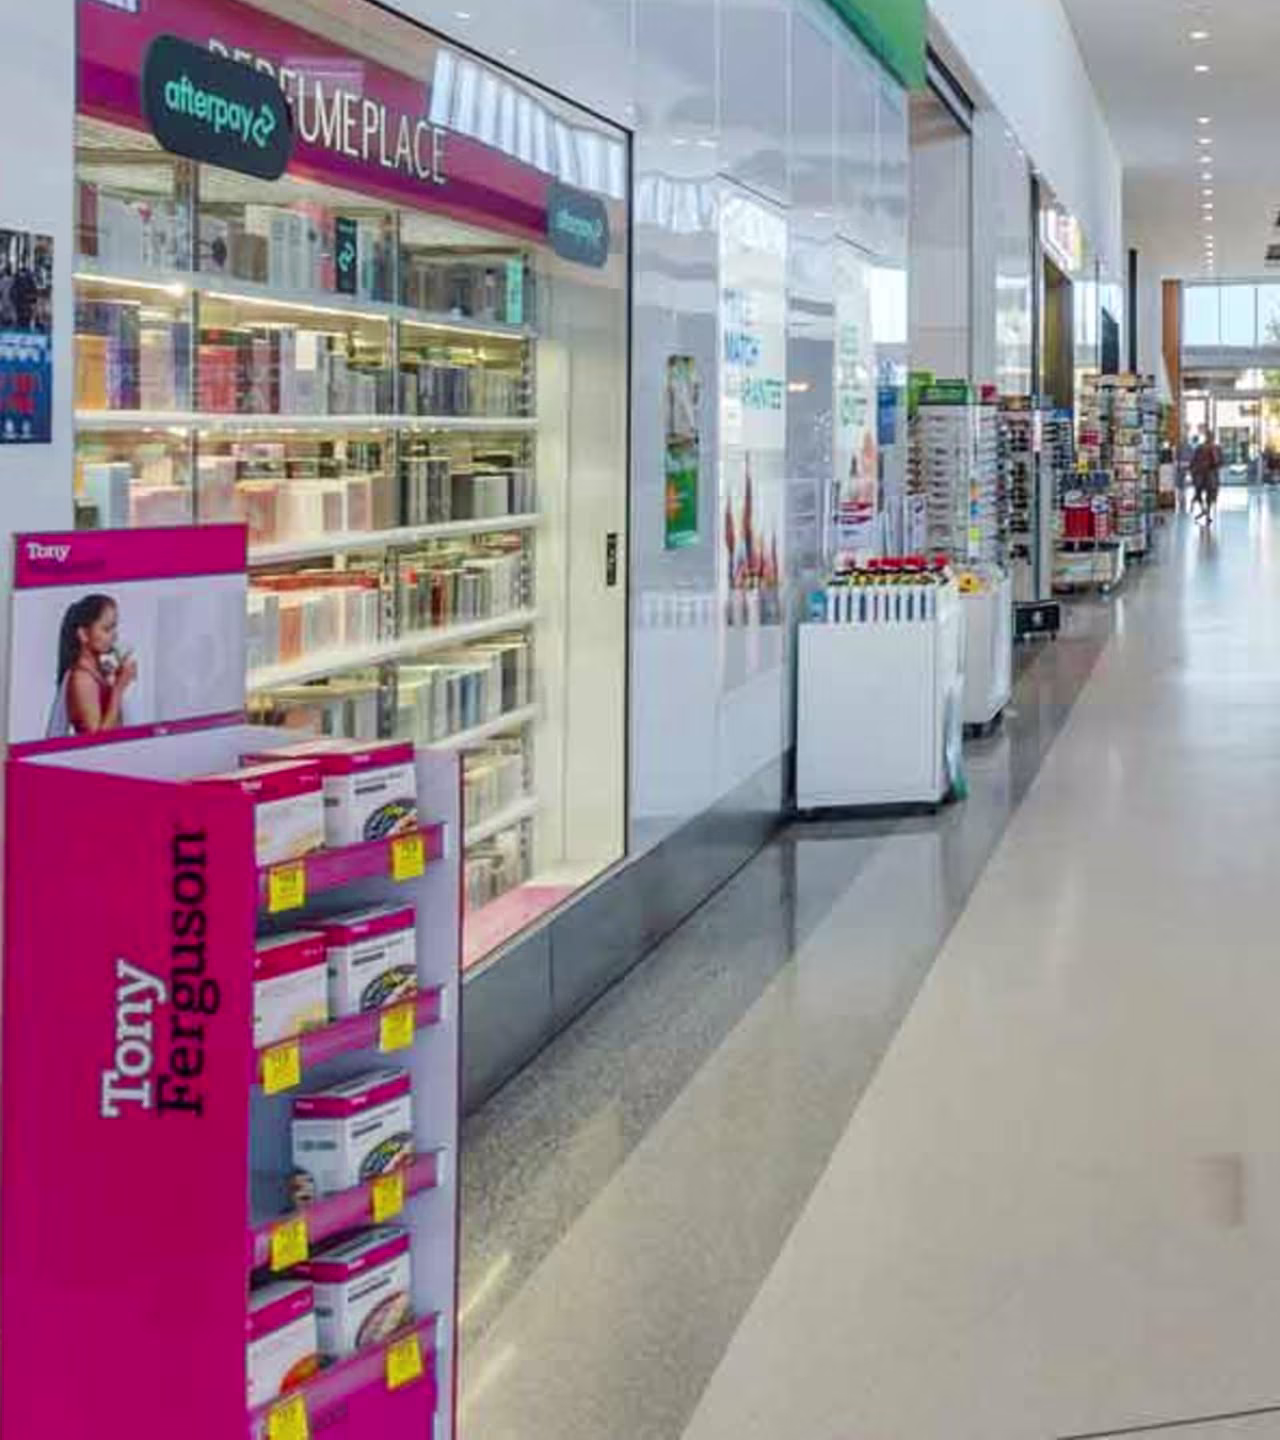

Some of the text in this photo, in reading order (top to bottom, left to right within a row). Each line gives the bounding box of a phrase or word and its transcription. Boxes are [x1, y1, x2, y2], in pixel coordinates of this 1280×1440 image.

[164, 75, 255, 142] afterpay
[26, 542, 71, 562] Tony
[156, 825, 220, 1117] Ferguson
[101, 958, 167, 1118] Tony
